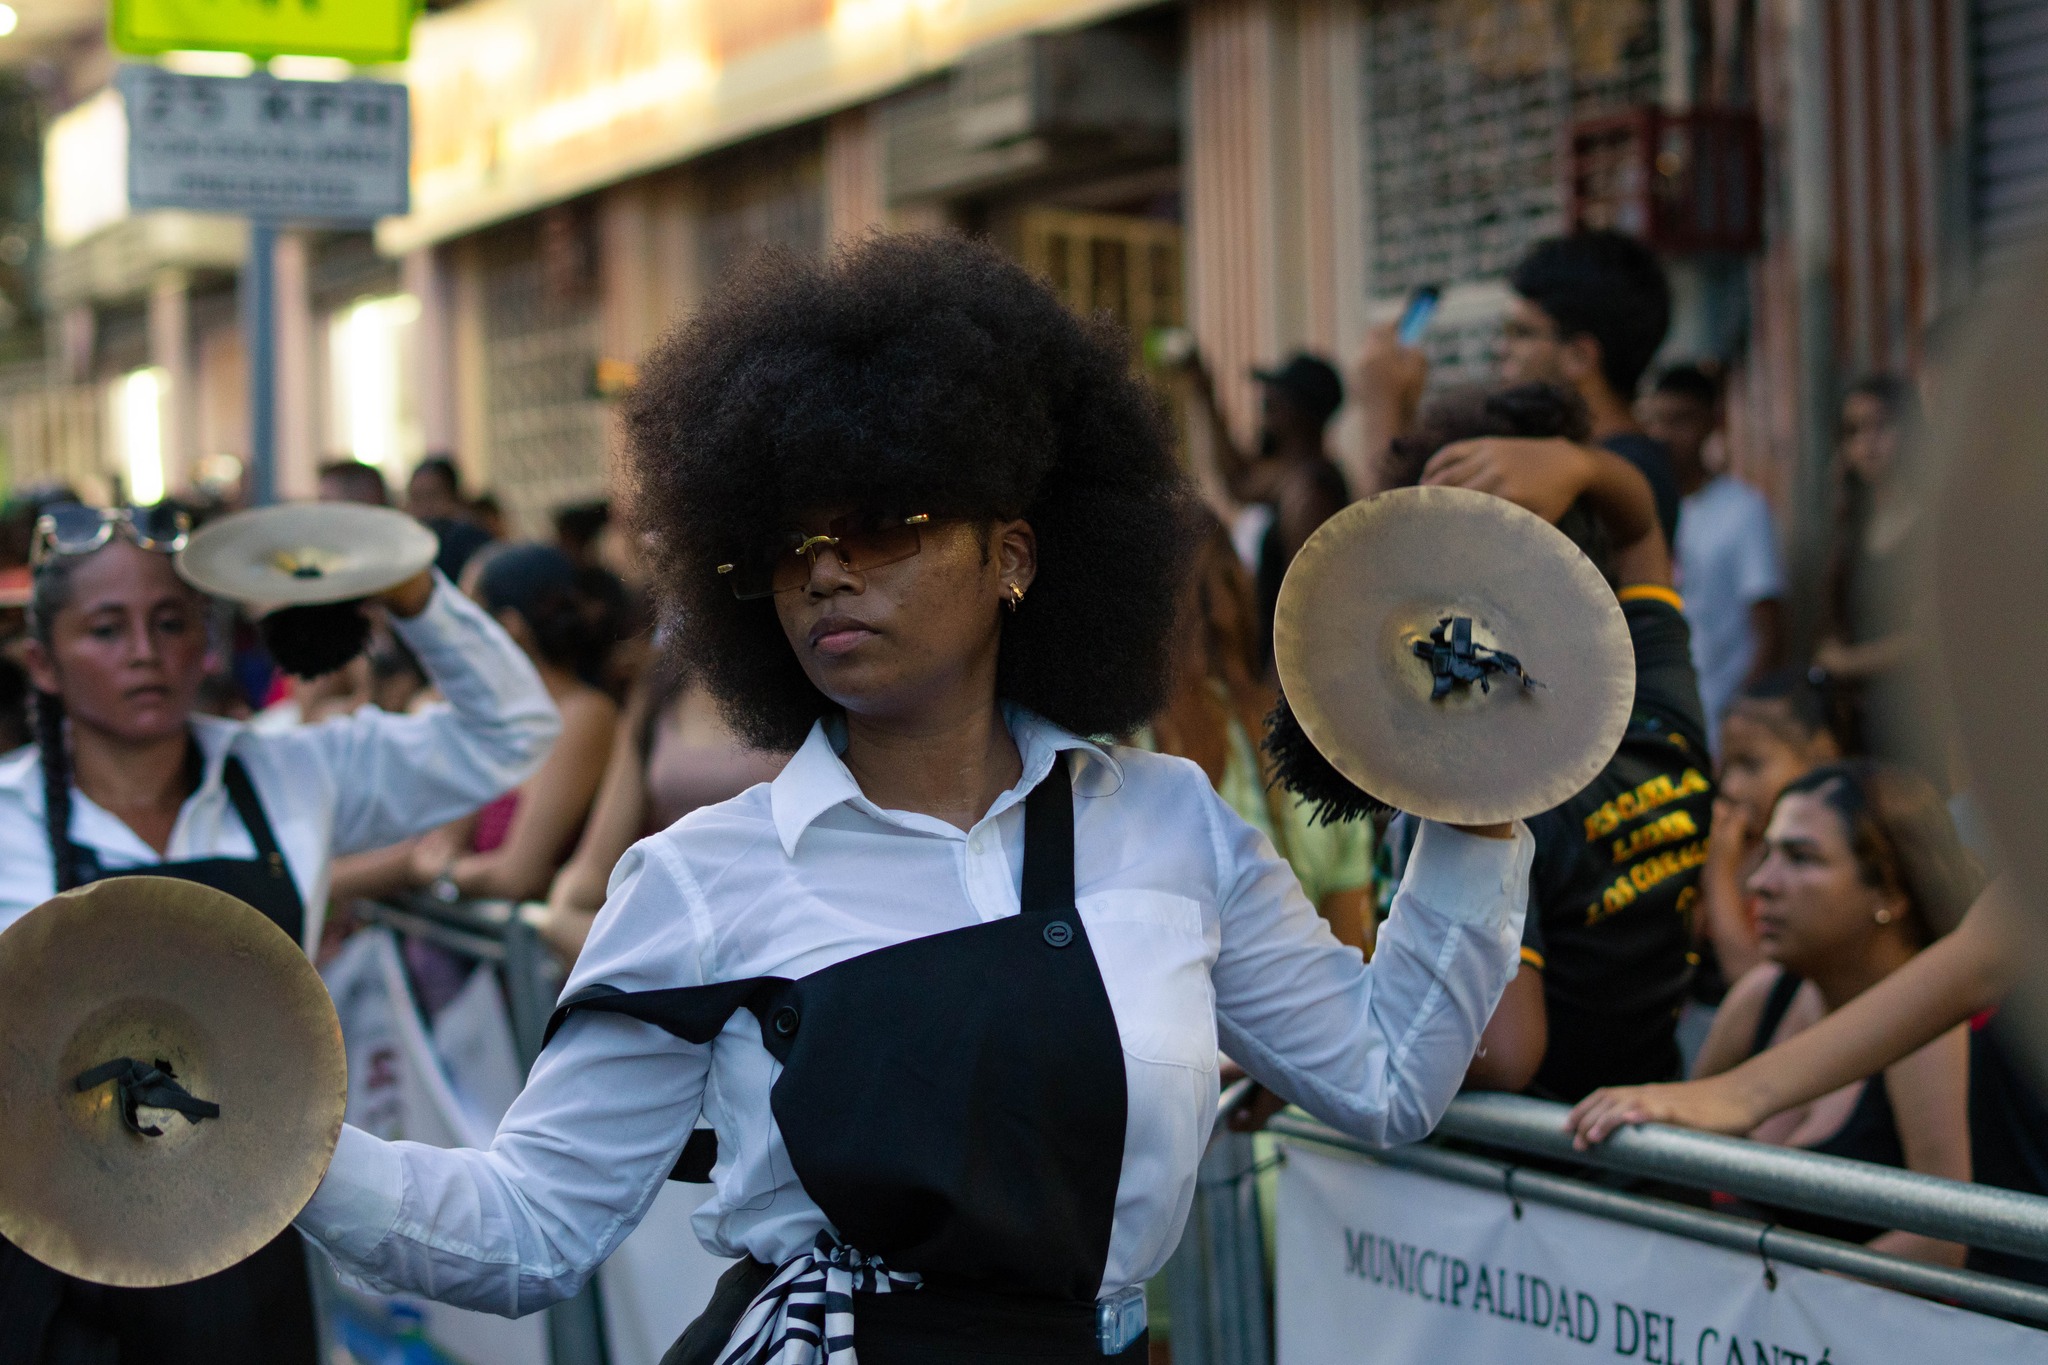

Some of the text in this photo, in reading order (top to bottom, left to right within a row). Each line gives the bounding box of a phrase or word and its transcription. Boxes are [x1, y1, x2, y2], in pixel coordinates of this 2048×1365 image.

[1584, 767, 1710, 842] ESCUELA
[1585, 875, 1636, 926] LOS
[1344, 1227, 1836, 1365] MUNICIPALIDAD DEL CAN
